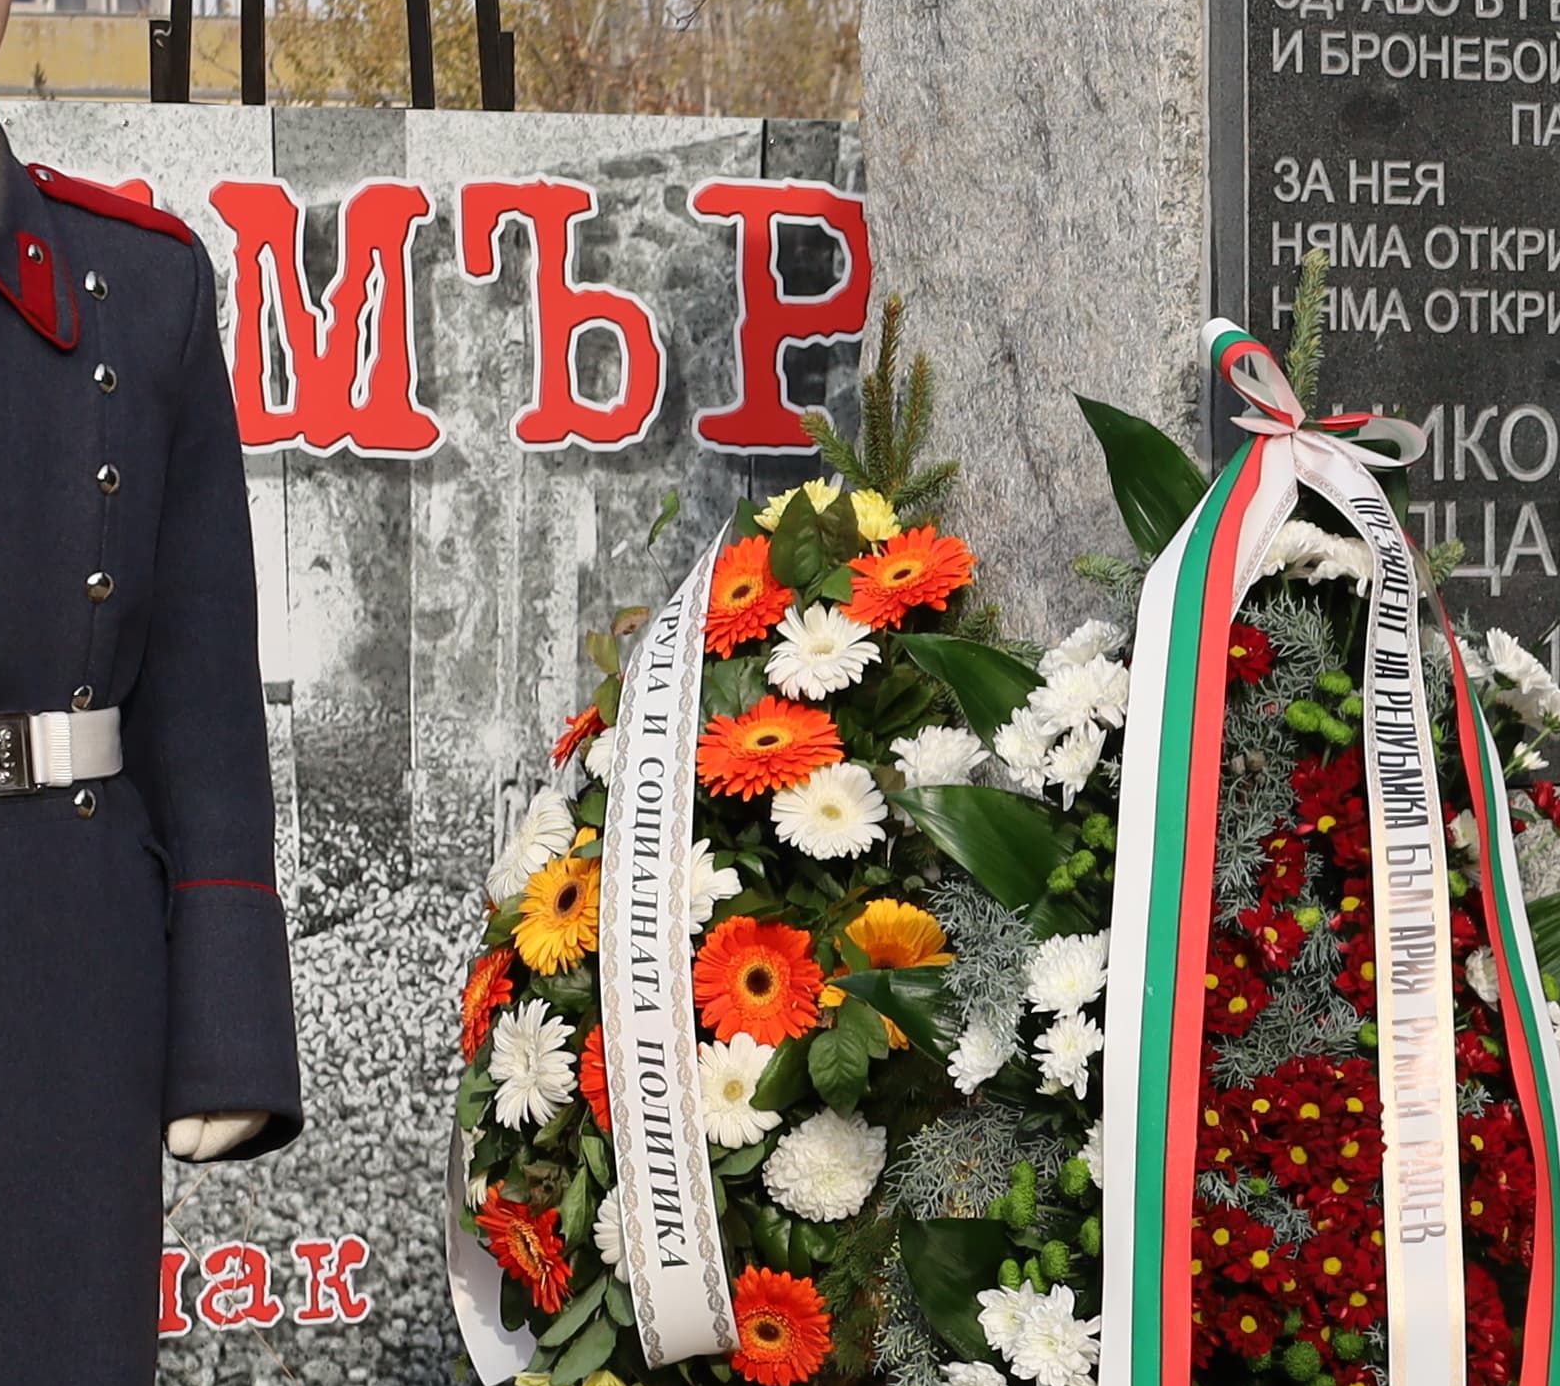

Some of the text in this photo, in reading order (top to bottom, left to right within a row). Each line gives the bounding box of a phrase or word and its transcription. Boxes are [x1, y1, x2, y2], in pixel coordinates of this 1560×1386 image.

[1272, 28, 1303, 74] И
[1272, 156, 1445, 206] ЗА НЕЯ
[1271, 221, 1412, 269] НЯМА
[1349, 496, 1448, 1245] ПРЕЗИДЕНТ НА РЕПУБЛИКА БЪЛГАРИЯ РУМЕН РАДЕВ
[628, 595, 687, 1271] ТРУДА И СОЦИАЛНАТА ПОЛИТИКА
